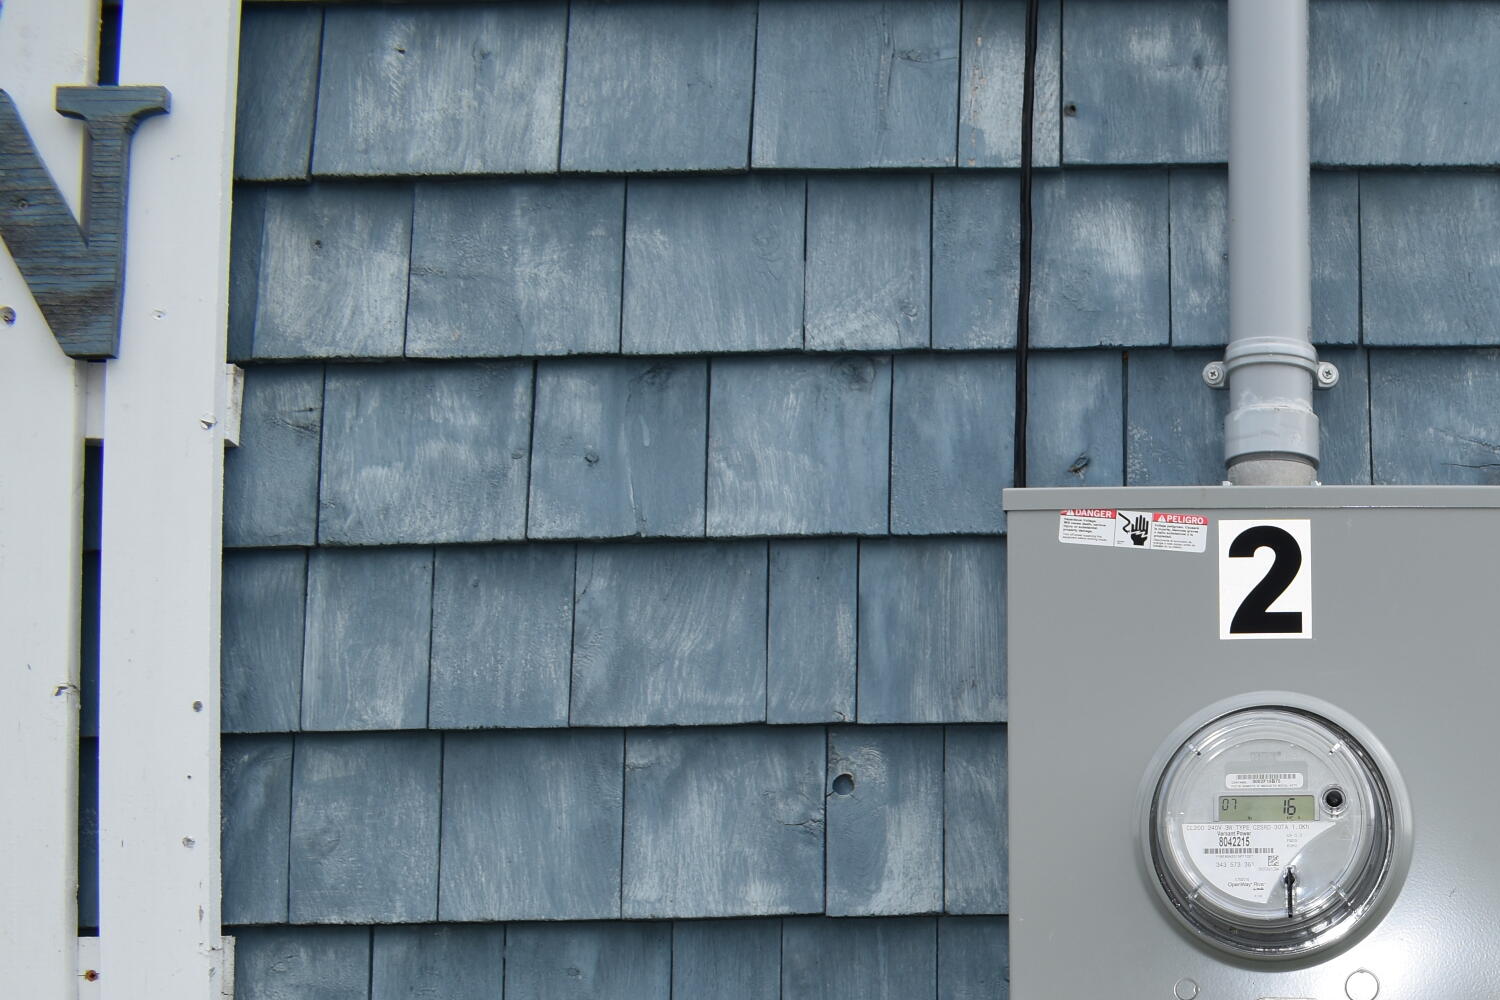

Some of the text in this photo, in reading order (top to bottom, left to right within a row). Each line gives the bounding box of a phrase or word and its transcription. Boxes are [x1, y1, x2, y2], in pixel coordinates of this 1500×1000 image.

[1075, 509, 1112, 518] DANGER
[1166, 515, 1204, 524] PELIGRO
[1228, 525, 1303, 634] 2
[1222, 798, 1296, 815] 07 16
[1219, 836, 1250, 846] 8042215
